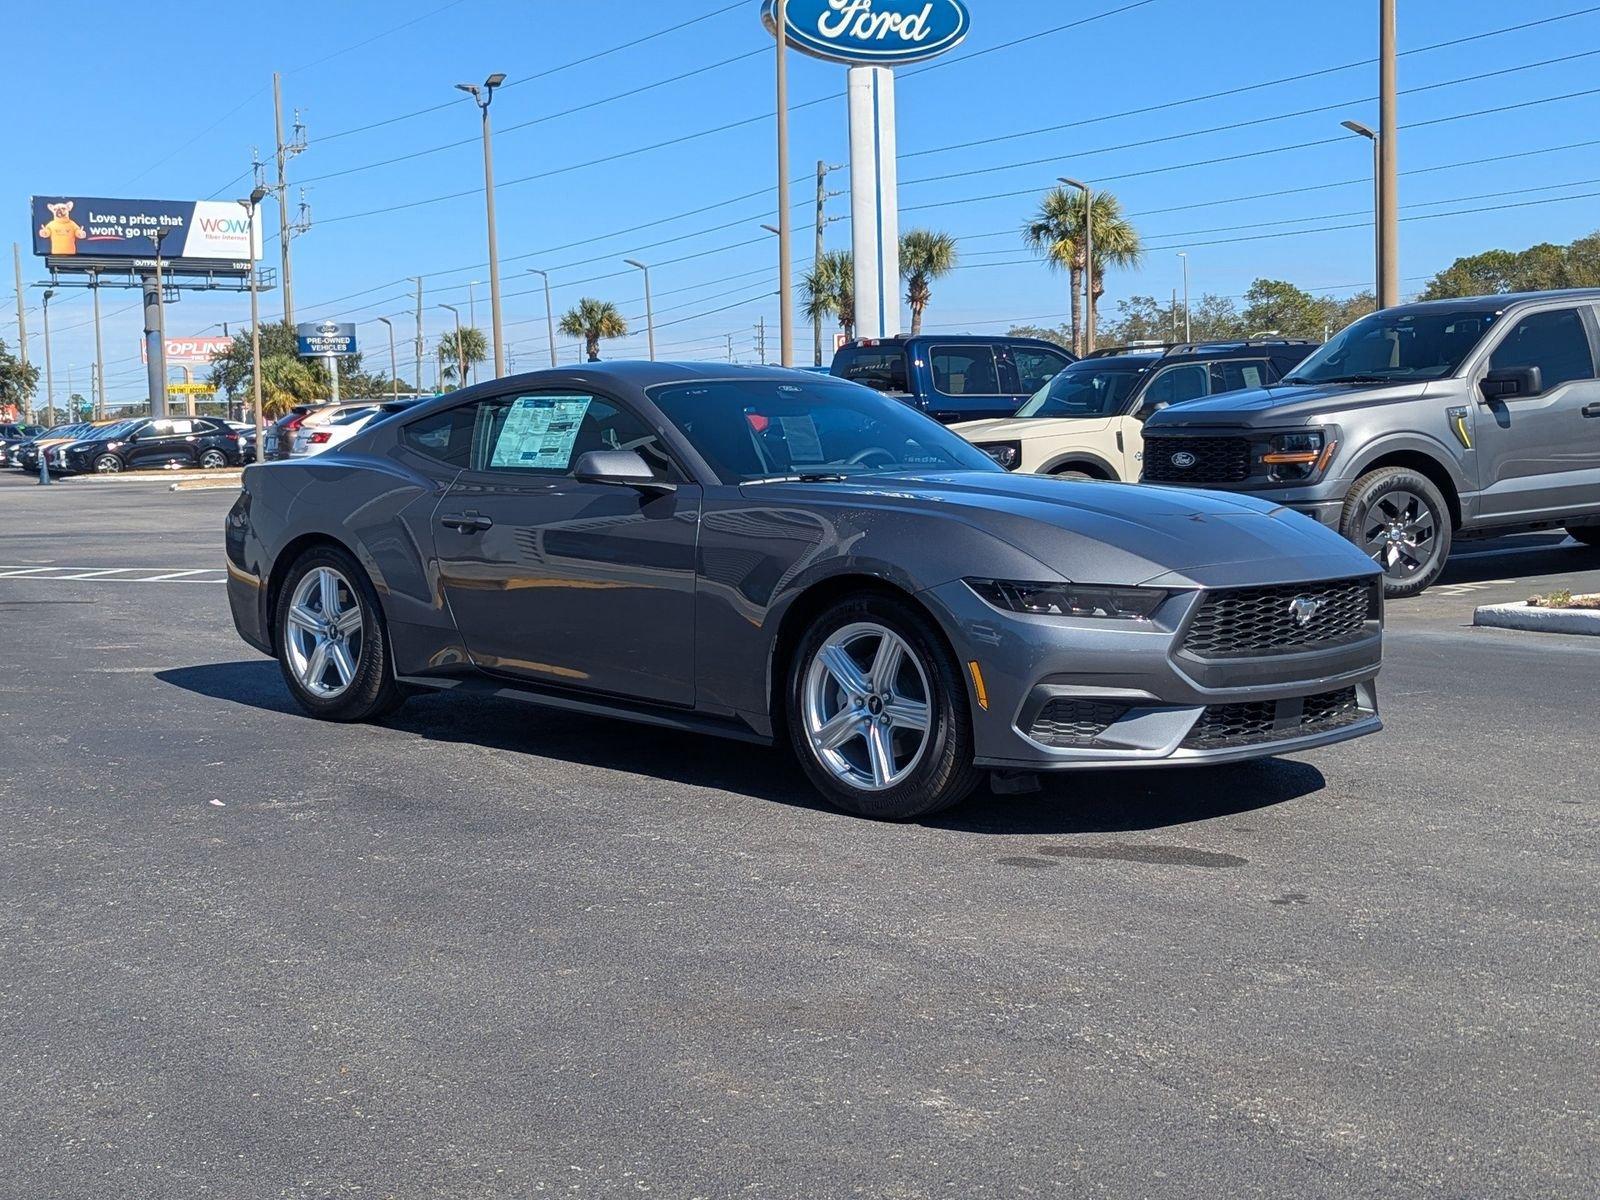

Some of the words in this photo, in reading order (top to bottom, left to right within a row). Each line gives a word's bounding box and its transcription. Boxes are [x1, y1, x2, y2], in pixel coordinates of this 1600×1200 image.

[817, 0, 933, 41] Ford
[89, 211, 117, 223] Love
[120, 215, 126, 224] a
[129, 213, 157, 226] price
[160, 215, 183, 226] that
[89, 225, 123, 236] won't
[125, 227, 140, 238] go
[306, 337, 351, 345] PRE-OWNED
[310, 344, 348, 352] VEHICLES
